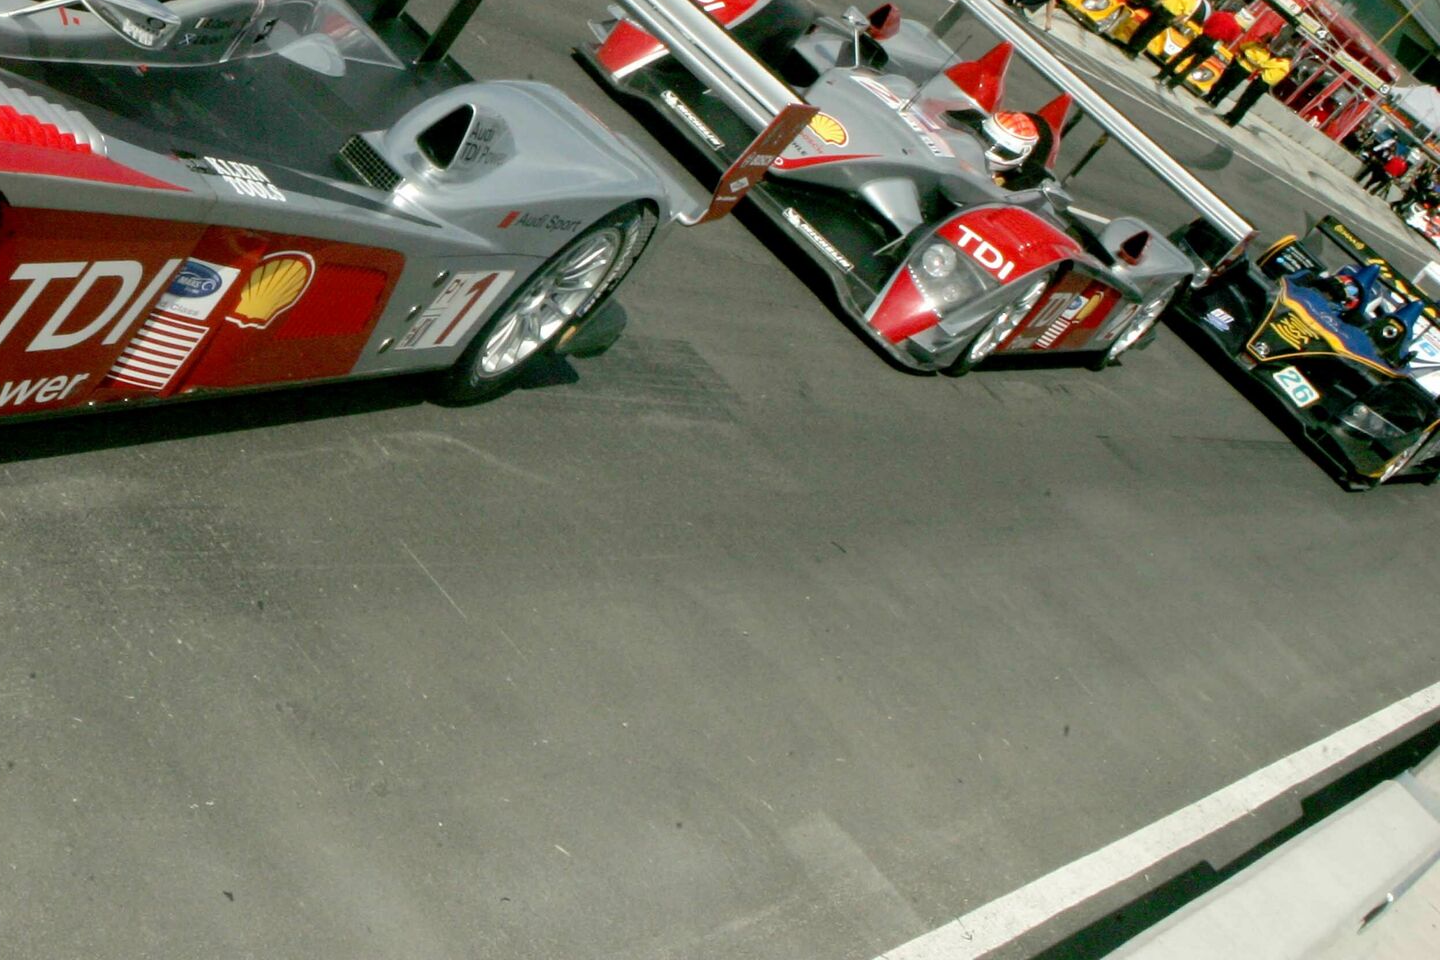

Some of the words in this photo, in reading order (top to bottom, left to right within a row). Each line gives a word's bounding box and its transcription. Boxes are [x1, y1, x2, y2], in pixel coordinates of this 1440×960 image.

[203, 156, 268, 183] KLEIN
[223, 175, 287, 202] TOOLS
[513, 212, 545, 229] Audi
[546, 215, 582, 234] Sport
[800, 222, 852, 268] MICHELIN
[956, 224, 1015, 280] TDI
[434, 273, 499, 345] 1
[1279, 372, 1313, 401] 26
